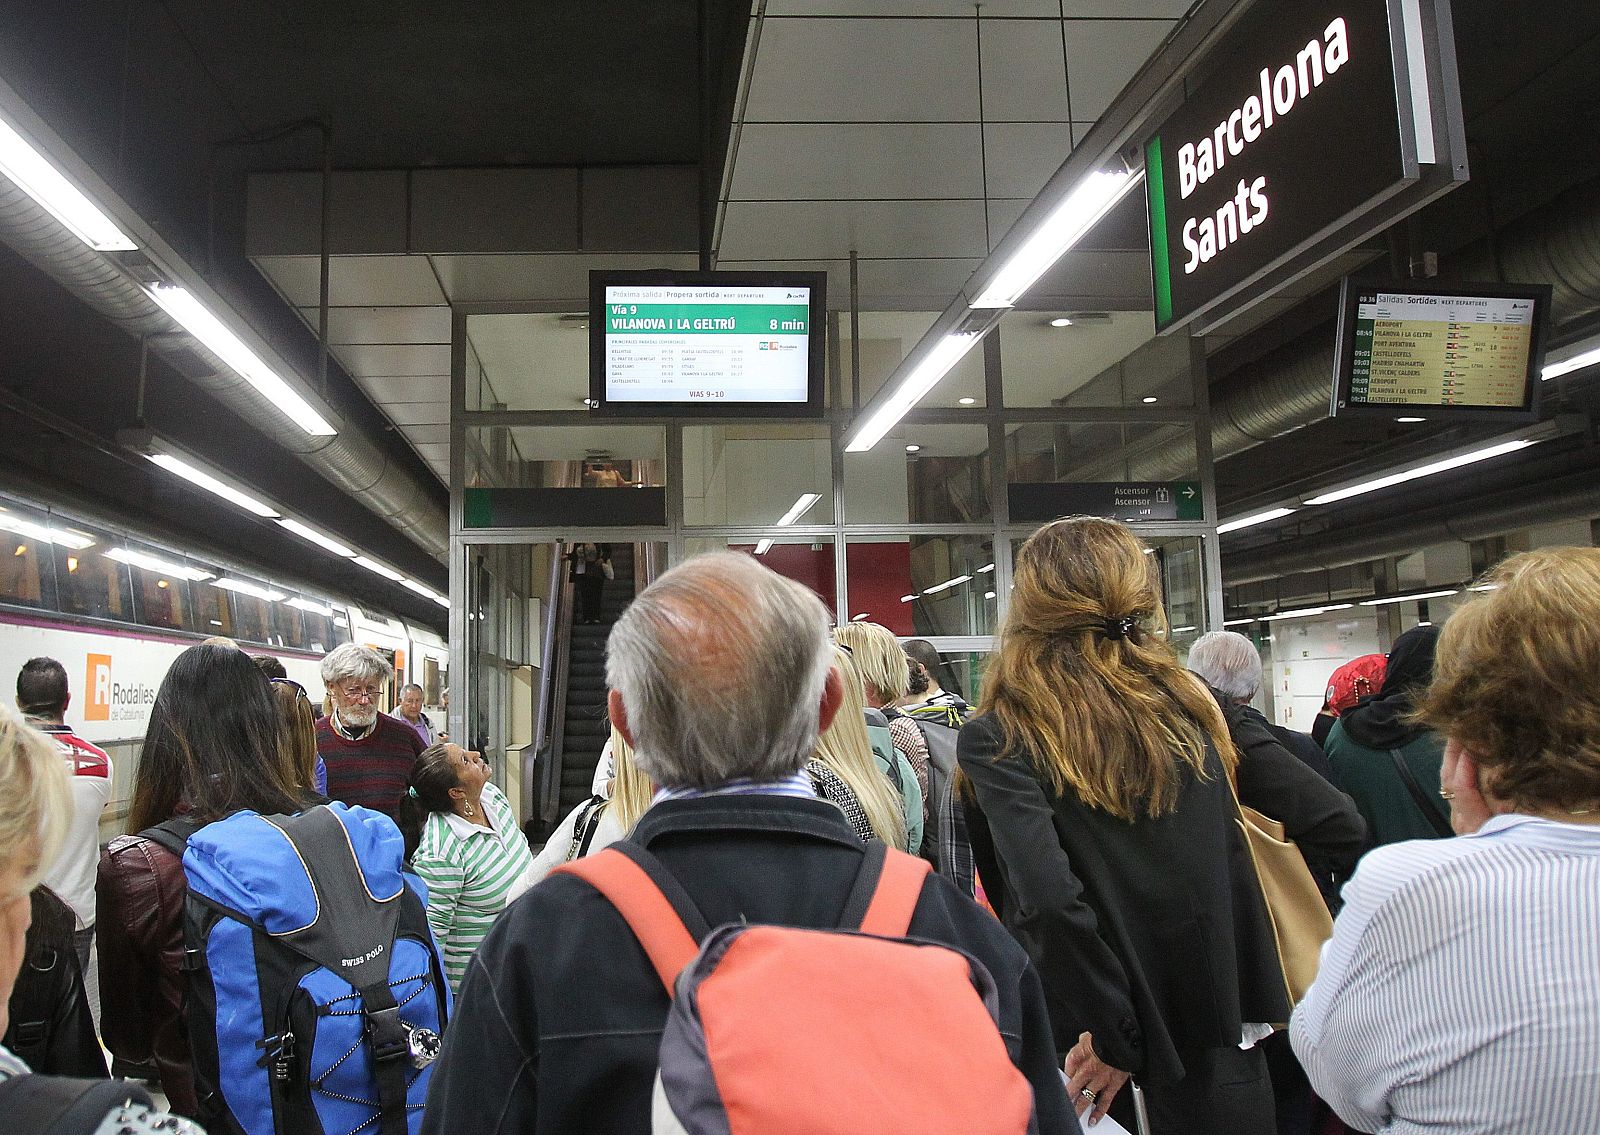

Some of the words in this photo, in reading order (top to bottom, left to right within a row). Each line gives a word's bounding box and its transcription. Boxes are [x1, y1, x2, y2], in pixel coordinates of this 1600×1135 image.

[1177, 16, 1350, 200] Barcelona
[1182, 176, 1269, 275] Sants
[666, 291, 693, 299] Propera
[1378, 295, 1404, 304] Salidas
[1407, 296, 1437, 305] Sortides
[611, 304, 627, 314] Vía
[630, 305, 637, 314] 9
[611, 319, 666, 329] VILANOVA
[669, 319, 673, 329] I
[677, 319, 691, 329] LA
[693, 316, 736, 329] GELTRÚ
[769, 319, 778, 330] 8
[781, 319, 805, 330] min
[1114, 487, 1150, 495] Ascensor
[1114, 497, 1151, 506] Ascensor
[94, 664, 110, 705] R
[112, 683, 155, 705] Rodalies
[341, 956, 365, 967] SWISS
[366, 944, 384, 961] POLO
